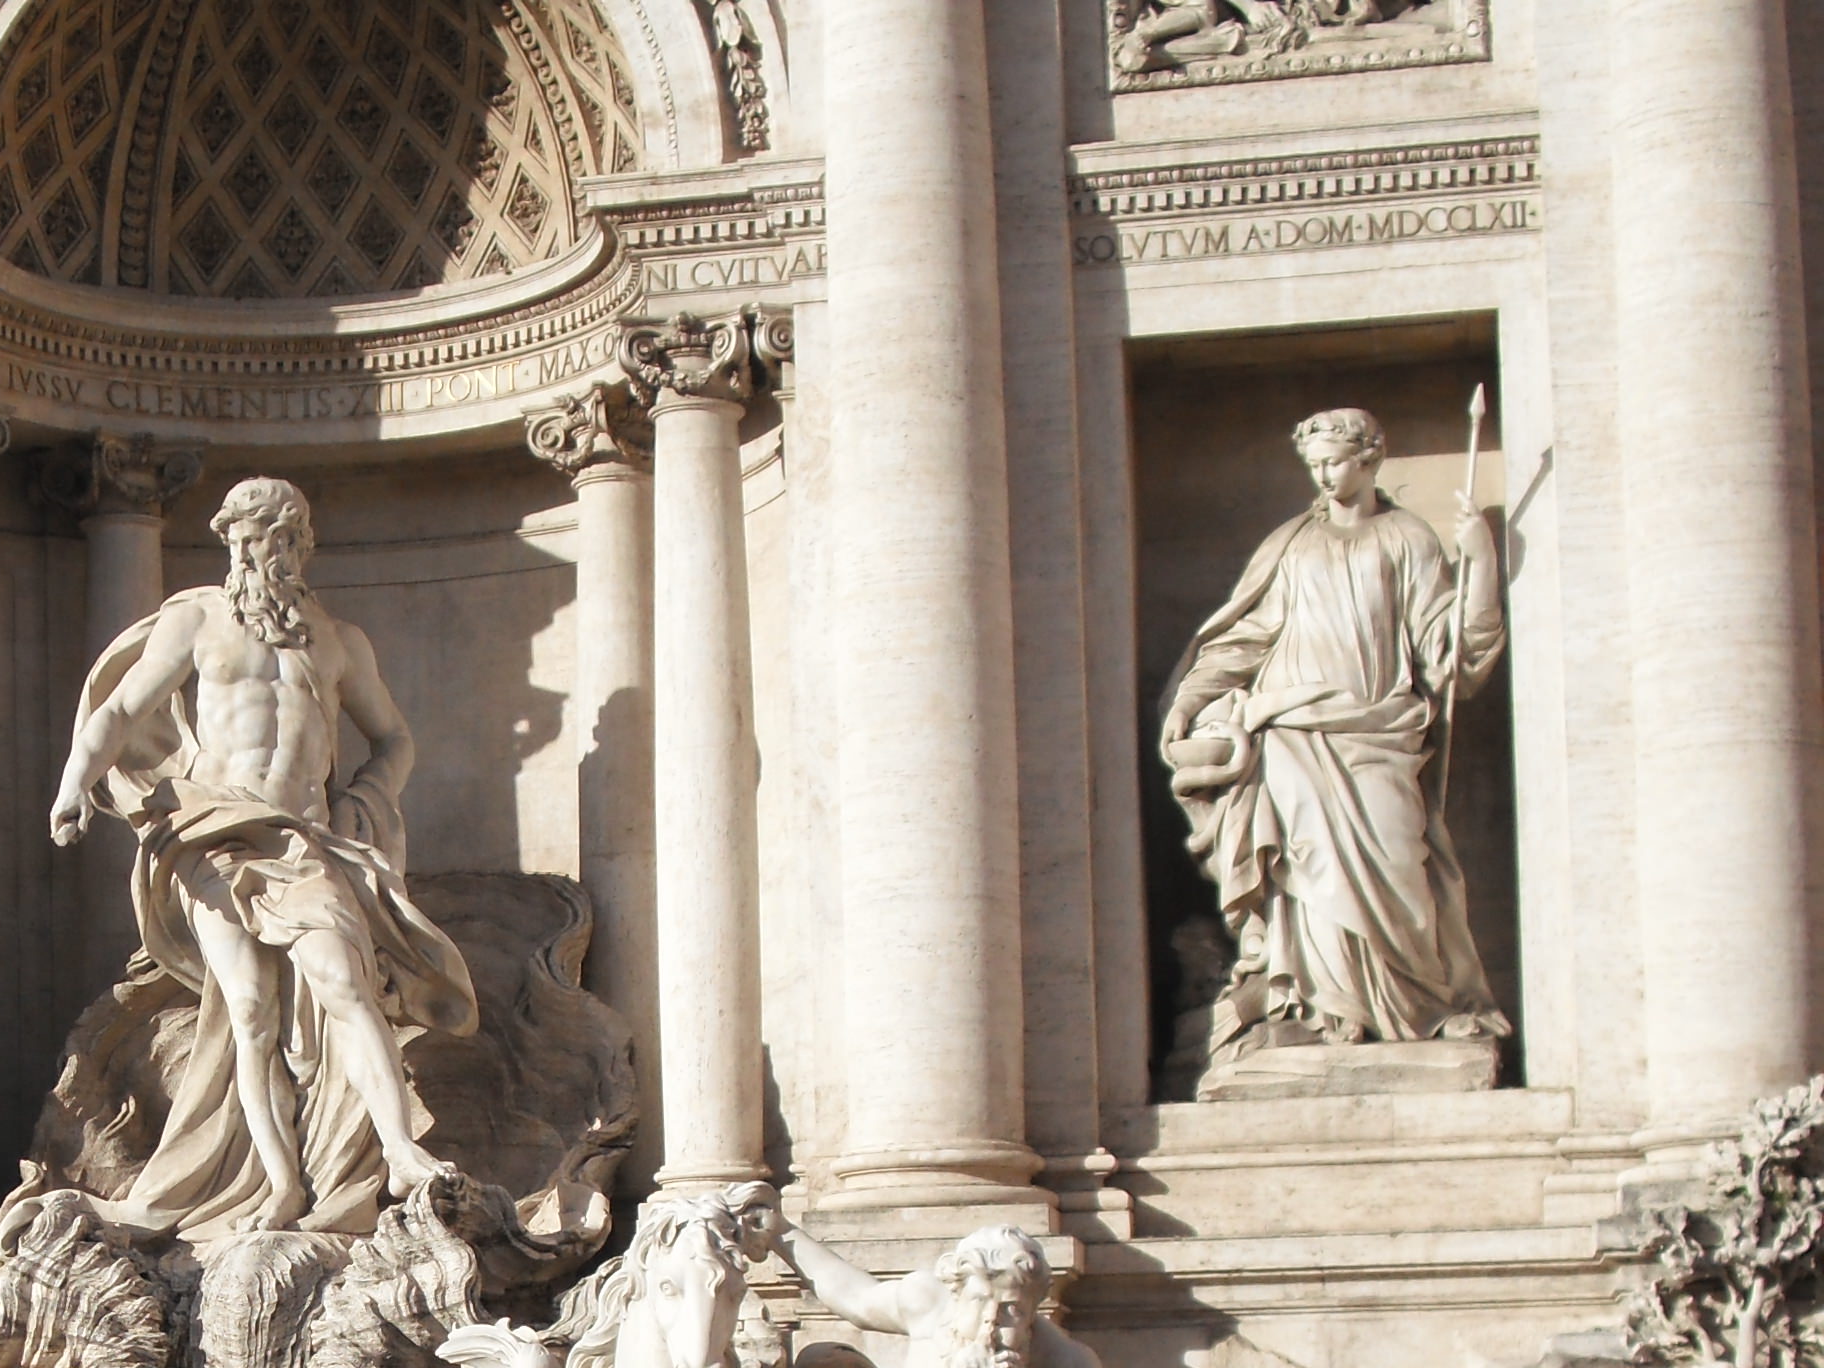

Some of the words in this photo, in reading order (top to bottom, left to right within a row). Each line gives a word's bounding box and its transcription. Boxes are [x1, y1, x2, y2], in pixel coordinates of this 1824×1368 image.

[1073, 224, 1230, 264] SOLVTVM
[7, 362, 83, 403] IVSSV
[105, 379, 332, 419] CLEMENTIS
[425, 360, 521, 408] PONT
[538, 335, 593, 385] MAX
